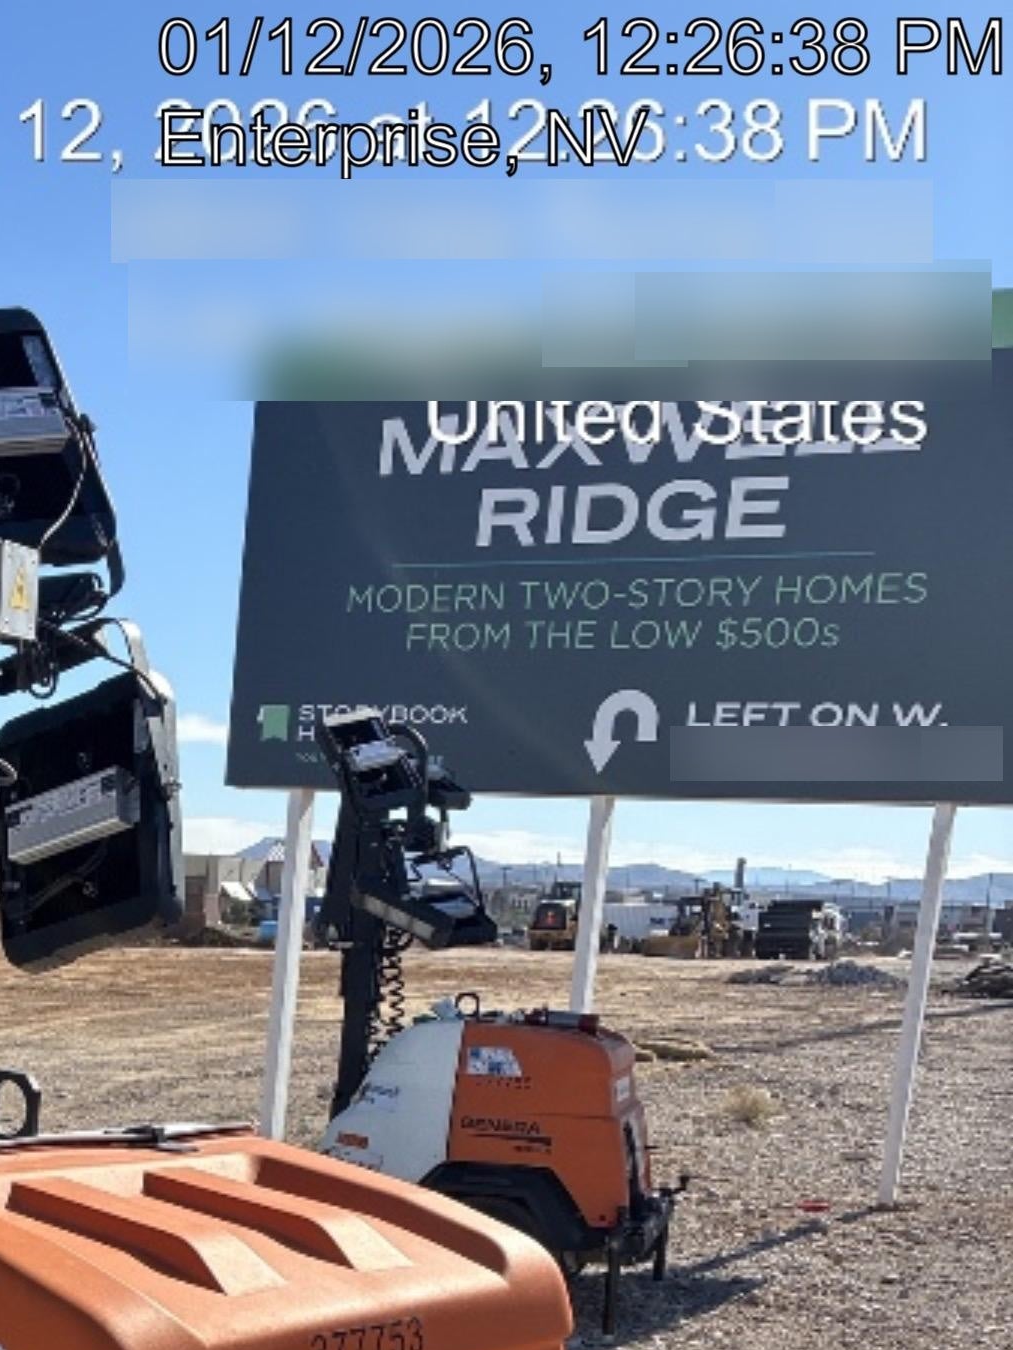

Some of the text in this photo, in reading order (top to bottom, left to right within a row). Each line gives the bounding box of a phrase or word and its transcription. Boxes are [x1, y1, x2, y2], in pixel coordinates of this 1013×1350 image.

[475, 475, 790, 547] RIDGE
[347, 573, 927, 613] MODERN TWO-STORY HOMES
[406, 616, 841, 651] FROM THE LOW $500s
[298, 704, 468, 724] STOYBOOK
[686, 701, 948, 726] LEFT ON W.
